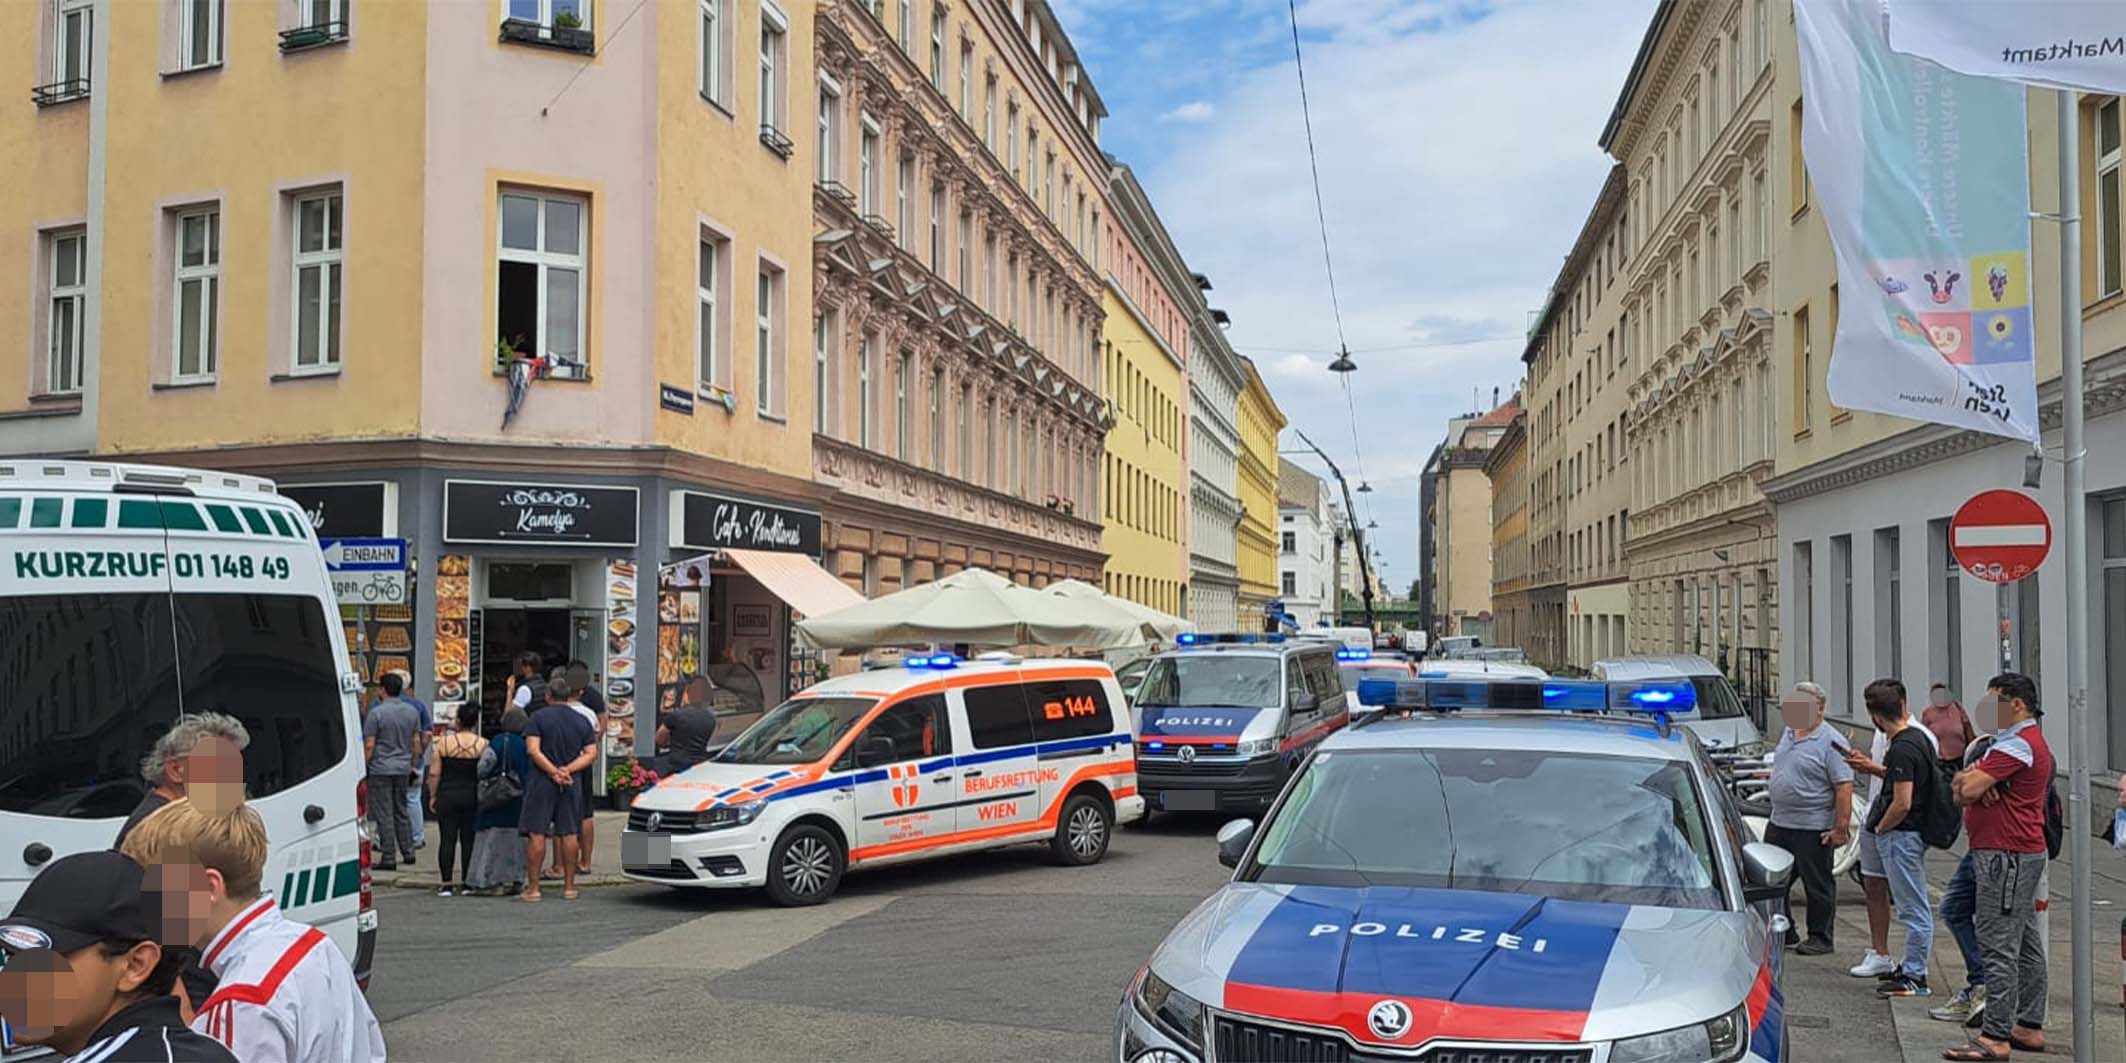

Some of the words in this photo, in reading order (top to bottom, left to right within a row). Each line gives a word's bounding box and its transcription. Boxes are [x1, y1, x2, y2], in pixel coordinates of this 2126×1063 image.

[516, 508, 574, 533] Kamelya
[14, 551, 166, 578] KURZRUF
[175, 553, 204, 579] 01
[211, 554, 254, 579] 148
[262, 556, 290, 580] 49
[343, 548, 395, 561] EINBAHN
[1064, 696, 1096, 718] 144
[1154, 716, 1234, 728] POLIZEI
[964, 768, 1059, 794] BERUFSRETTUNG
[978, 802, 1017, 820] WIEN
[1309, 921, 1549, 954] POLIZEI
